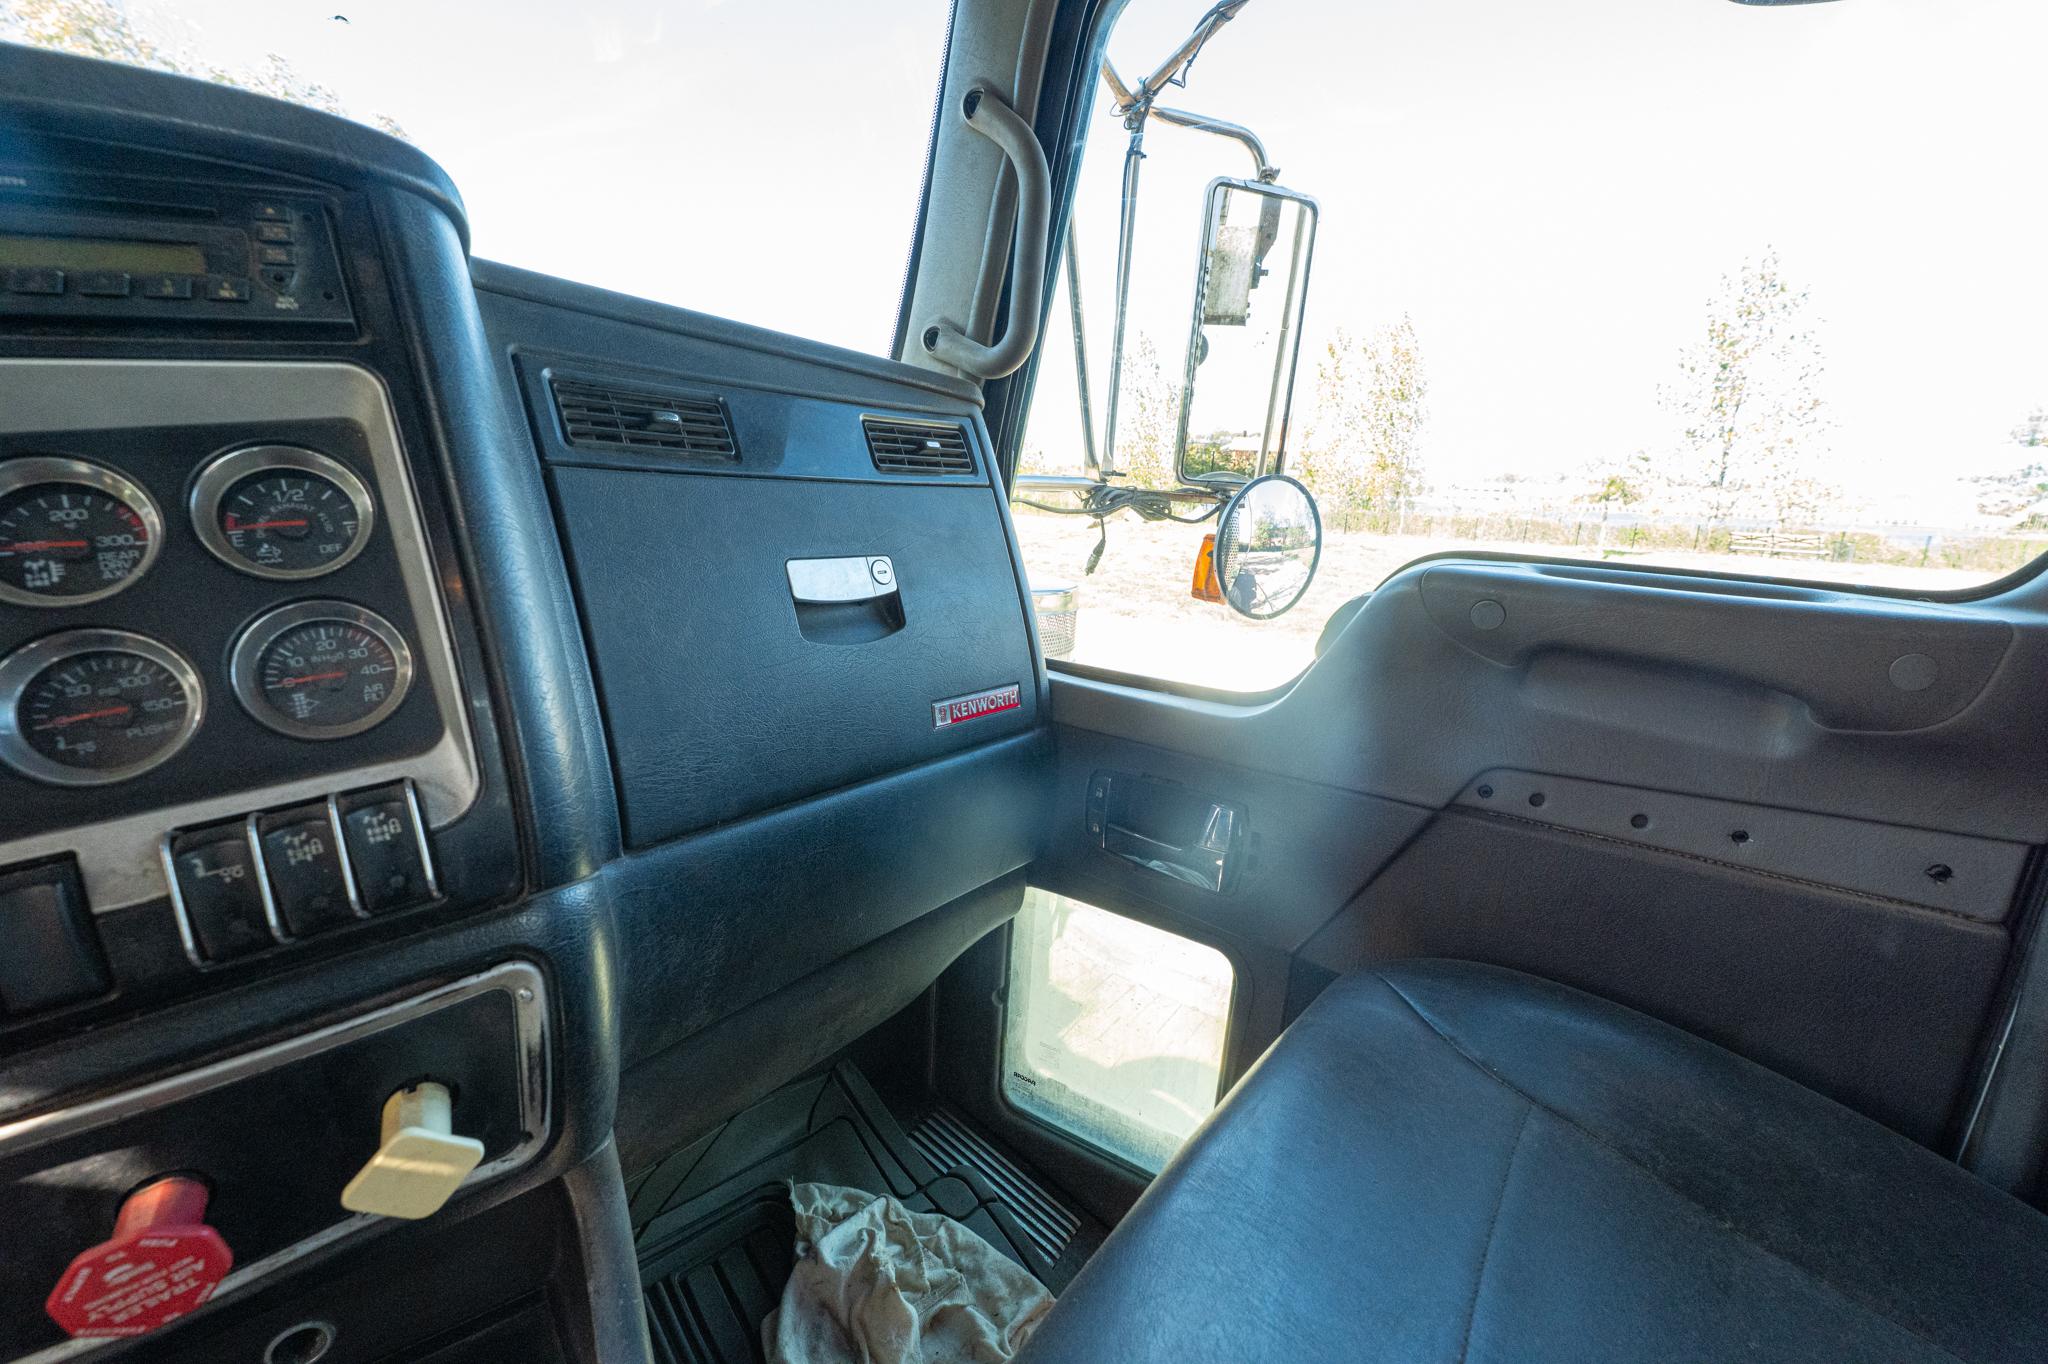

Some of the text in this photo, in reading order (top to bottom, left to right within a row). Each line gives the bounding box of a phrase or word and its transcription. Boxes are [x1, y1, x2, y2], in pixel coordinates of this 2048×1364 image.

[271, 489, 304, 502] 1/2
[48, 508, 88, 522] 200
[95, 535, 134, 548] 300
[232, 534, 244, 547] E
[98, 549, 139, 561] REAR
[319, 543, 342, 554] DEF
[315, 639, 336, 651] 20
[347, 648, 368, 659] 30
[286, 656, 304, 668] 10
[361, 664, 380, 674] 40
[117, 675, 150, 688] 100
[65, 684, 92, 697] 50
[952, 690, 1018, 719] KENWORTH
